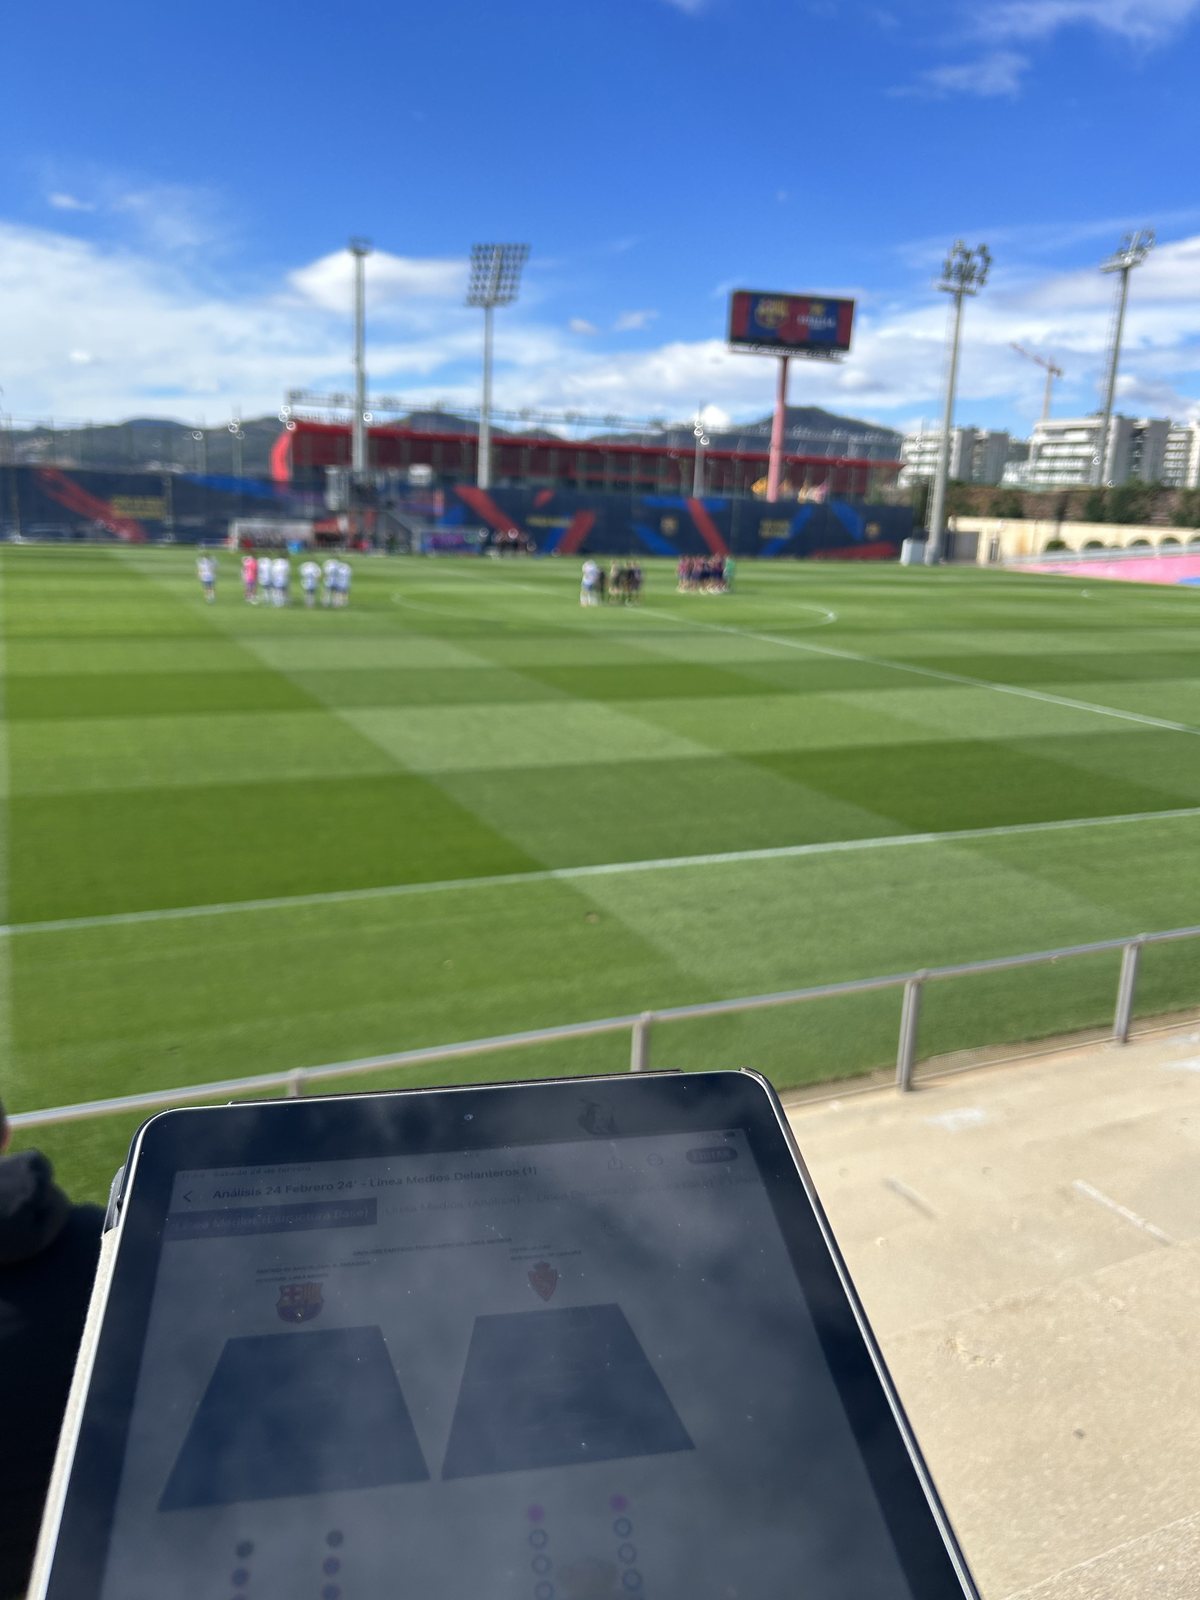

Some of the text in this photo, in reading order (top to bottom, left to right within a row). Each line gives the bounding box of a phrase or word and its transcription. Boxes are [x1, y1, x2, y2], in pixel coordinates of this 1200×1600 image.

[213, 1186, 262, 1200] Análisis
[266, 1184, 281, 1196] 24
[285, 1180, 334, 1194] Febrero
[406, 1172, 450, 1185] Medios
[454, 1168, 519, 1182] Delanteros
[522, 1165, 537, 1177] (1)
